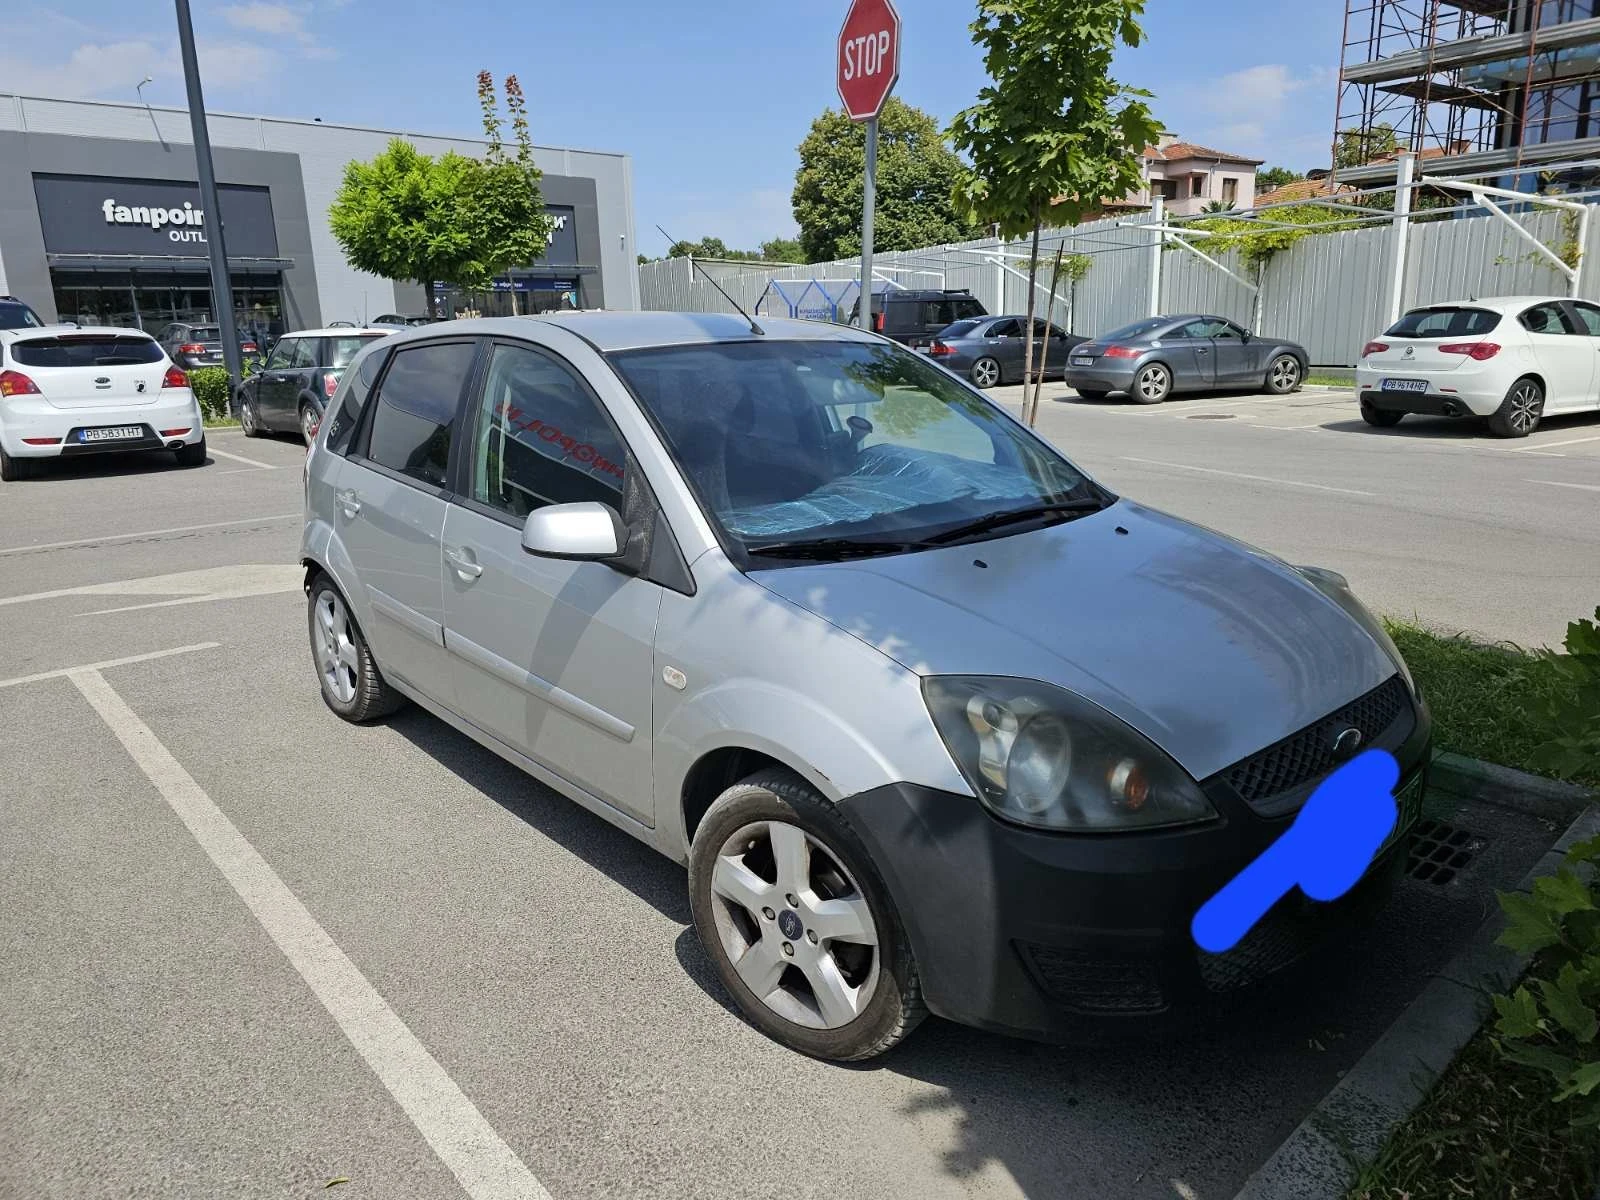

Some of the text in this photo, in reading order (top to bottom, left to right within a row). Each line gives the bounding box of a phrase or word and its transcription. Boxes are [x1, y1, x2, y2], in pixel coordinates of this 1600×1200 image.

[844, 30, 890, 80] STOP
[102, 199, 204, 229] fanpoin
[169, 231, 208, 243] OUTL
